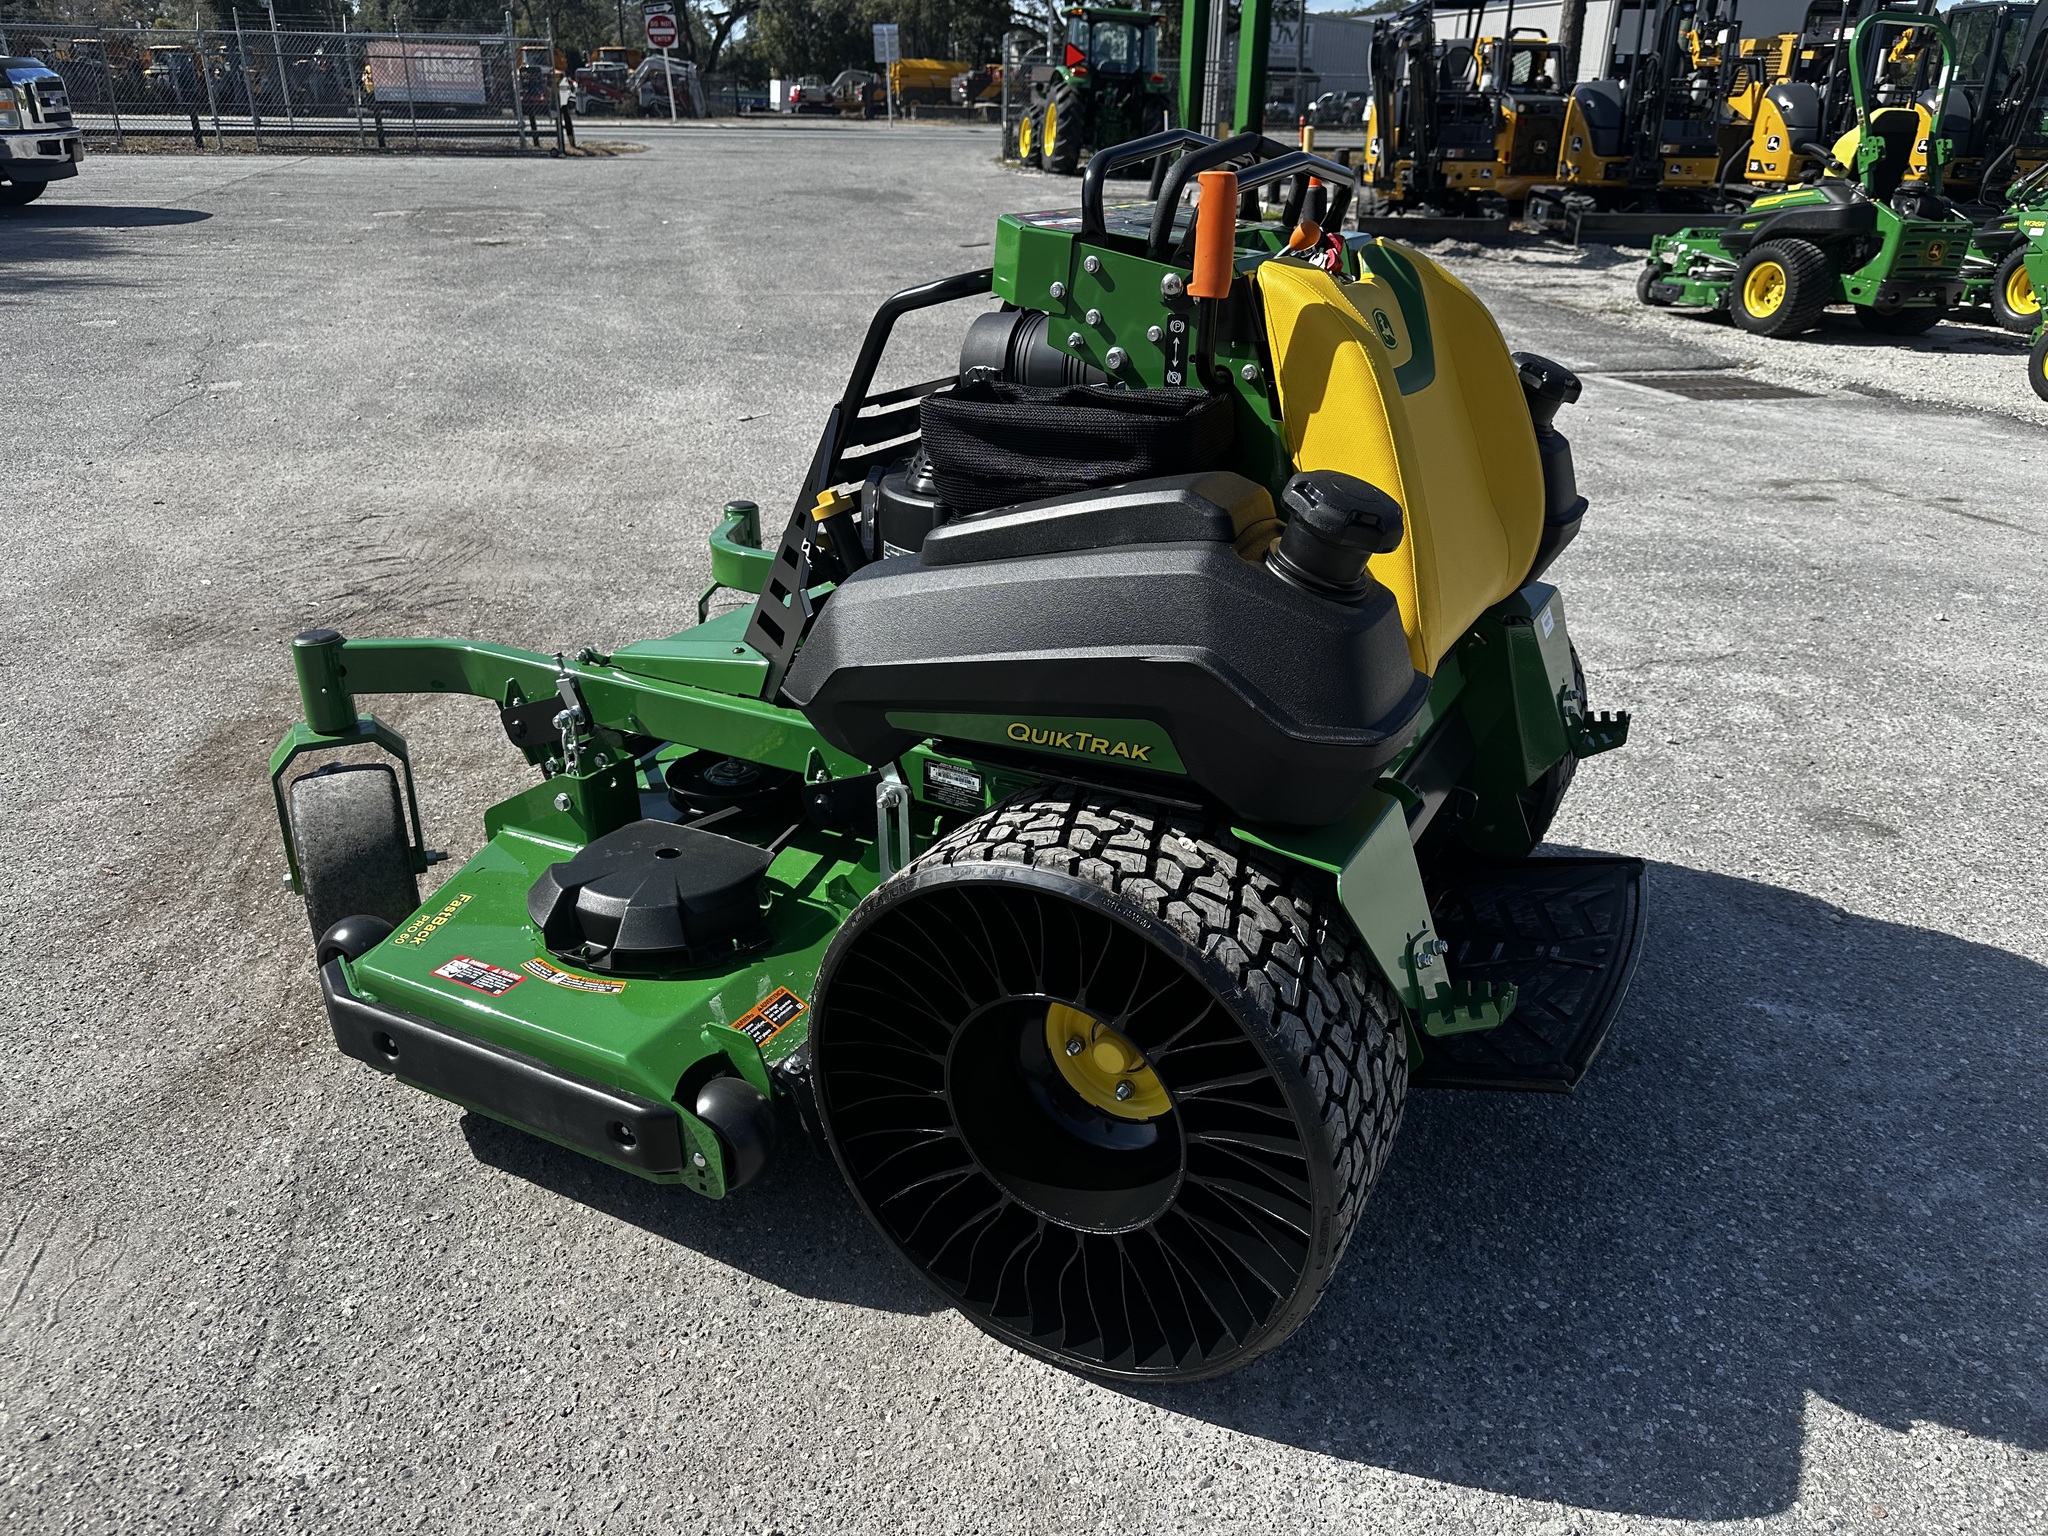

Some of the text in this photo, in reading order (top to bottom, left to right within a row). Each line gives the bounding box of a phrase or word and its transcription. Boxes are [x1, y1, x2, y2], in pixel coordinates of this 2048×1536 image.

[394, 914, 431, 944] PRO 60
[409, 893, 473, 946] FastBack
